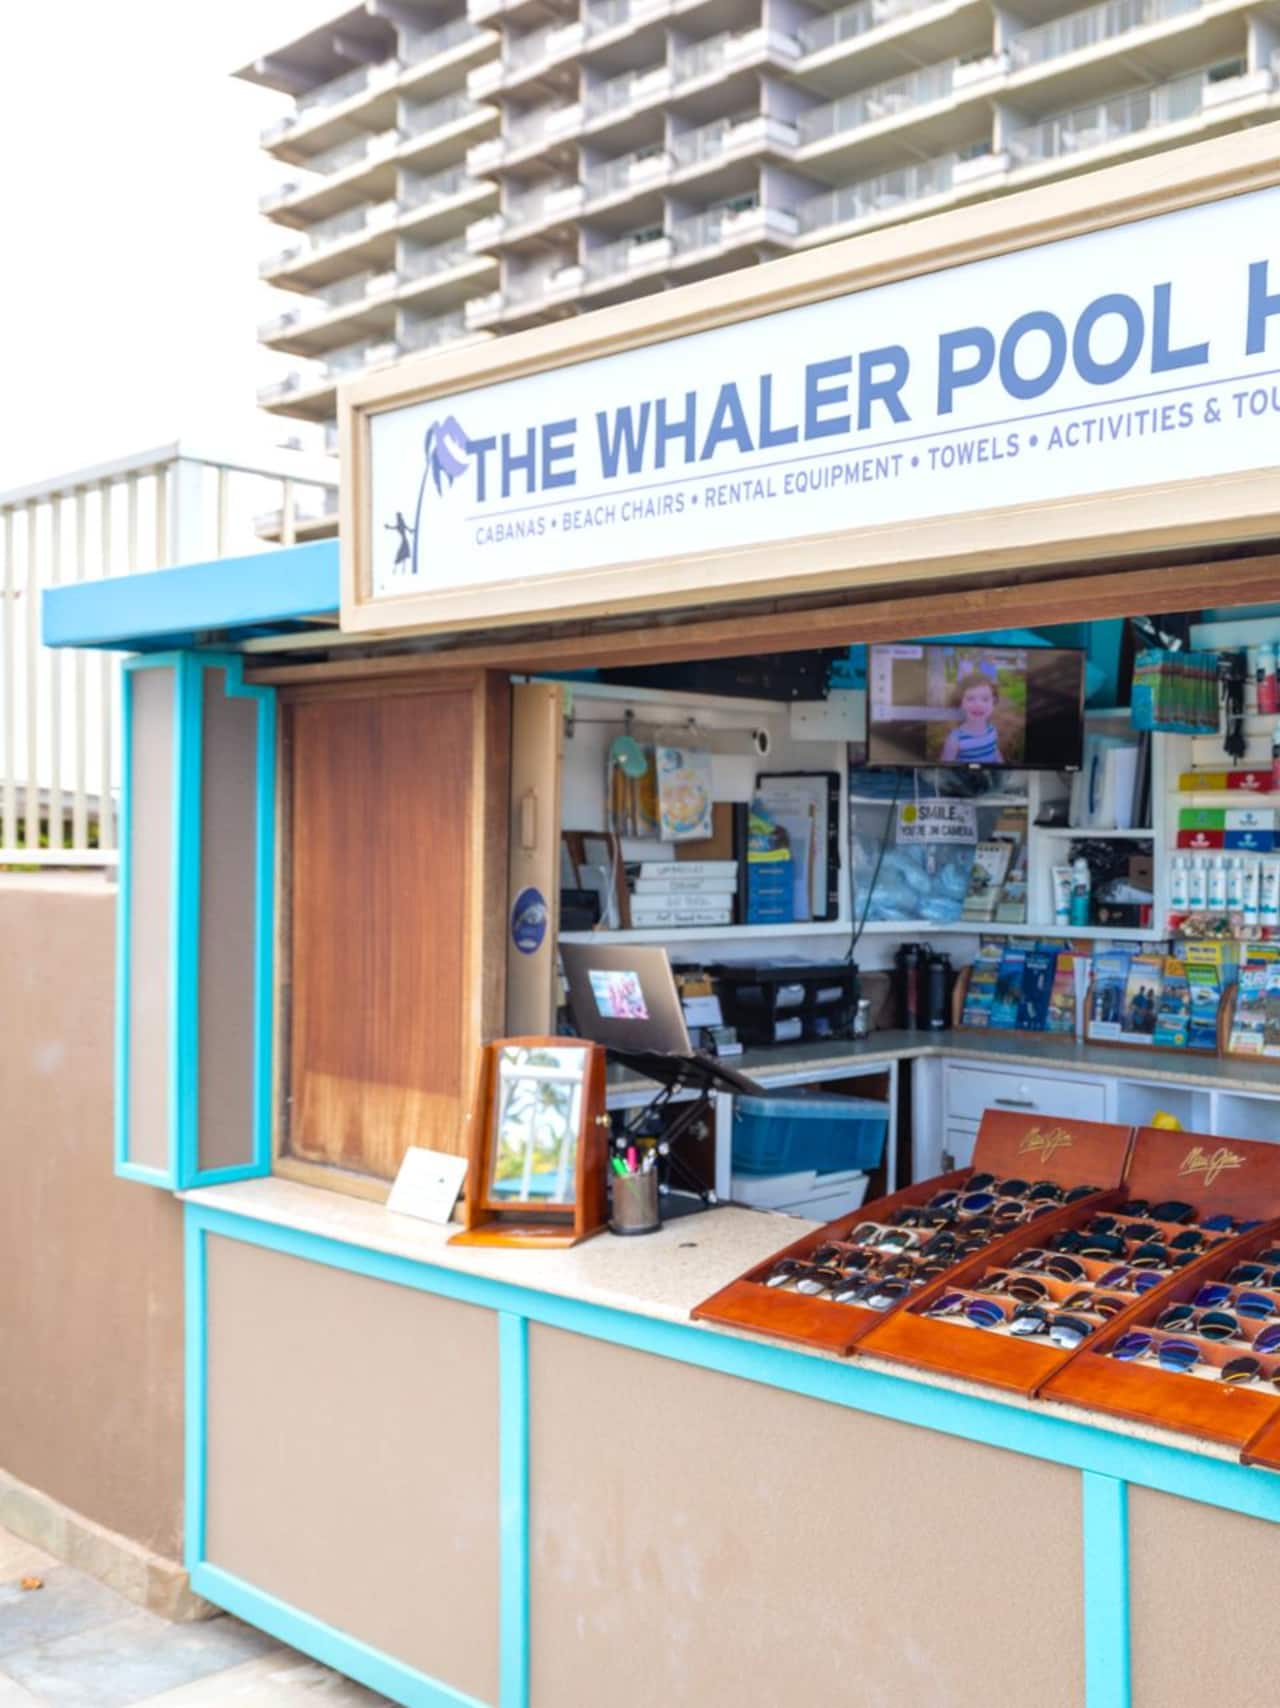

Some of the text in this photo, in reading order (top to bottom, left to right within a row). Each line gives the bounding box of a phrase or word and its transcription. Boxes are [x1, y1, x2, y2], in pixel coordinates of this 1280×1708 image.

[467, 418, 577, 501] THE
[597, 345, 911, 479] WHALER
[938, 284, 1209, 416] POOL
[475, 516, 547, 545] CABANAS
[562, 497, 616, 532] BEACH
[620, 491, 686, 523] CHAIRS
[705, 475, 778, 509] RENTAL
[783, 455, 903, 496] EQUIPMENT
[926, 434, 1020, 471] TOWELS
[1047, 403, 1194, 451] ACTIVITIES
[1203, 397, 1222, 423] &
